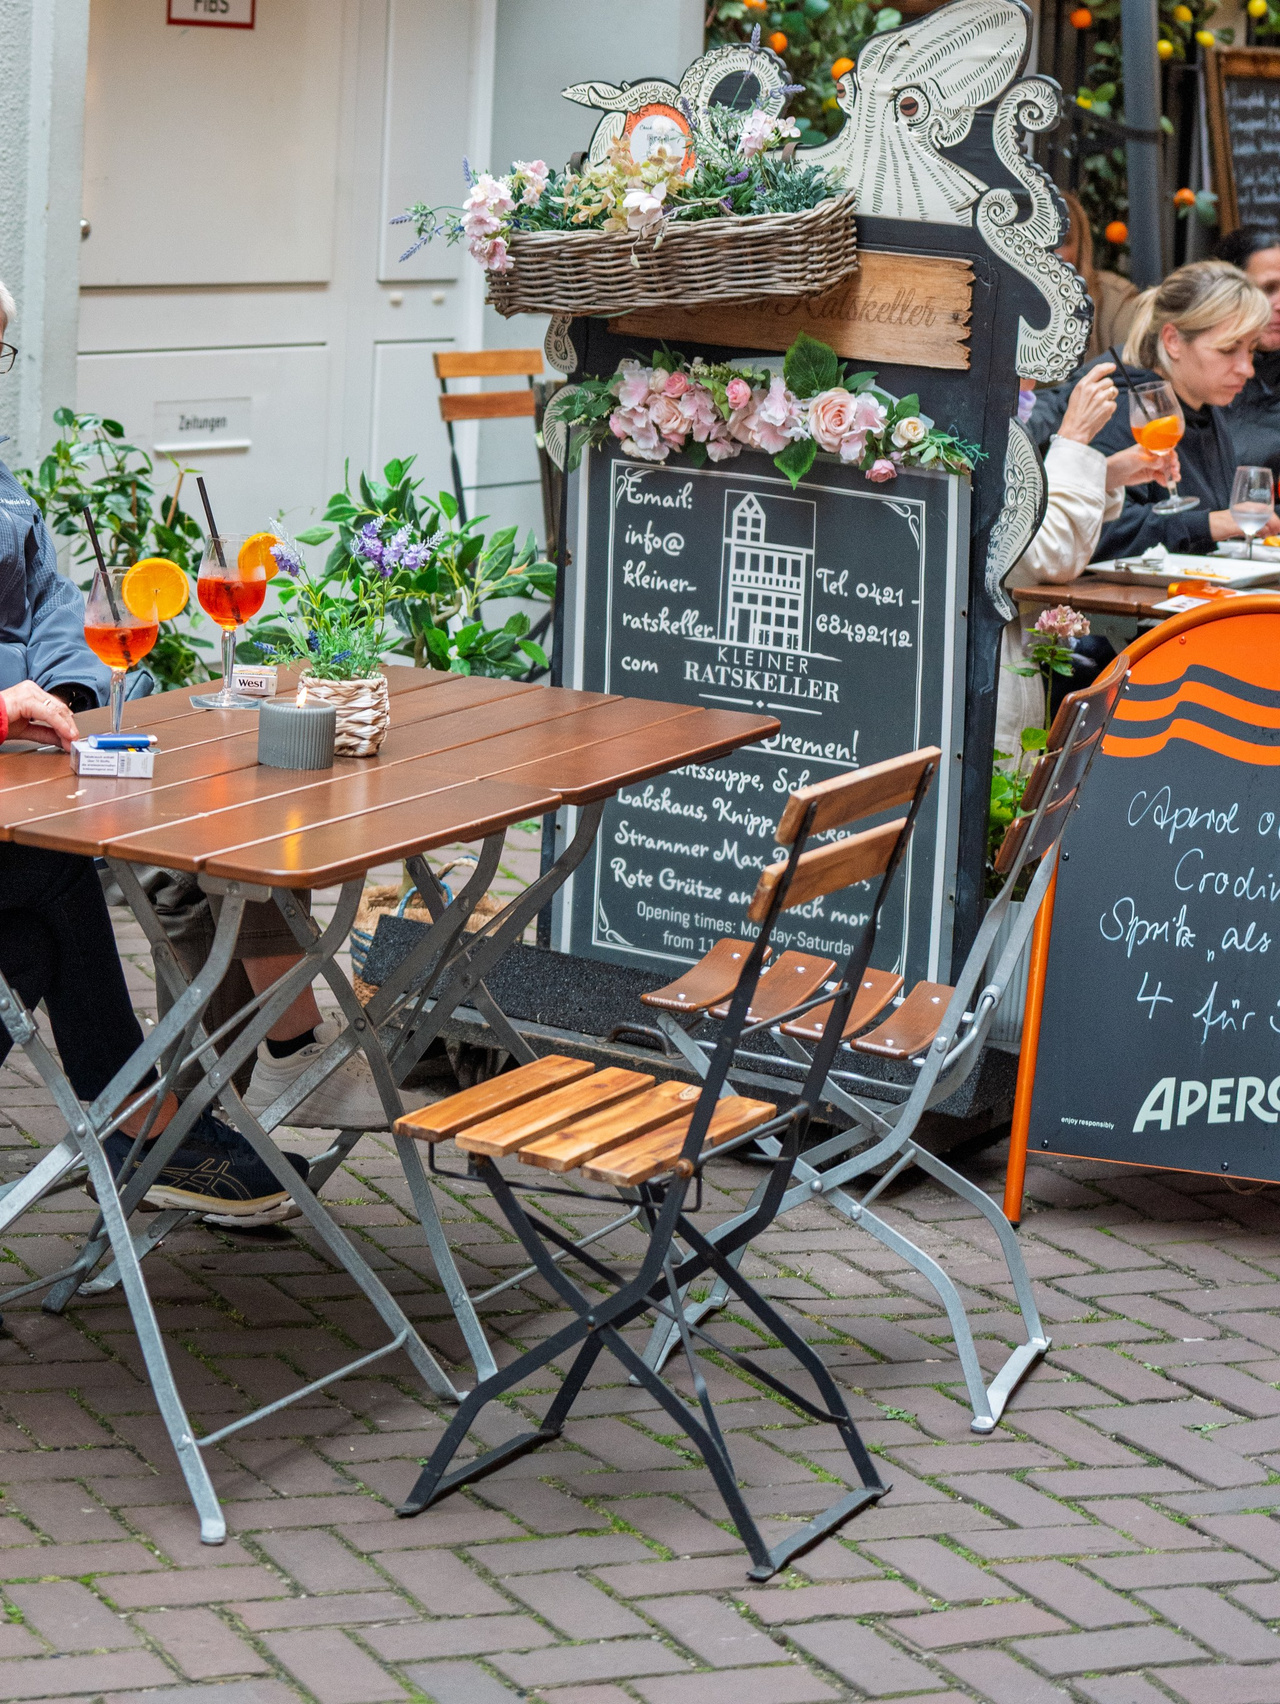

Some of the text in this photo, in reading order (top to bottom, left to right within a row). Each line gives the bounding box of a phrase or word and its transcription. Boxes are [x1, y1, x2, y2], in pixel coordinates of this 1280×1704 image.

[179, 414, 227, 433] Zeitungen
[625, 478, 693, 510] Email:
[624, 520, 685, 556] info@
[622, 559, 697, 593] kleiner-
[815, 567, 850, 598] Tel.
[855, 582, 904, 607] 0421
[622, 606, 716, 640] ratskeller.
[815, 614, 913, 649] 68492112
[621, 655, 659, 674] com
[717, 646, 809, 675] KLEINER
[238, 678, 264, 689] West
[684, 660, 840, 703] RATSKELLER
[712, 797, 777, 838] Knipp,
[614, 820, 709, 858] Strammer
[610, 857, 653, 889] Rote
[659, 868, 722, 900] Grütze
[637, 901, 690, 927] Opening
[694, 912, 736, 934] times:
[663, 931, 694, 951] from
[1136, 971, 1174, 1019] 4
[1192, 981, 1256, 1045] für
[1060, 1116, 1115, 1130] enjoy responsibly
